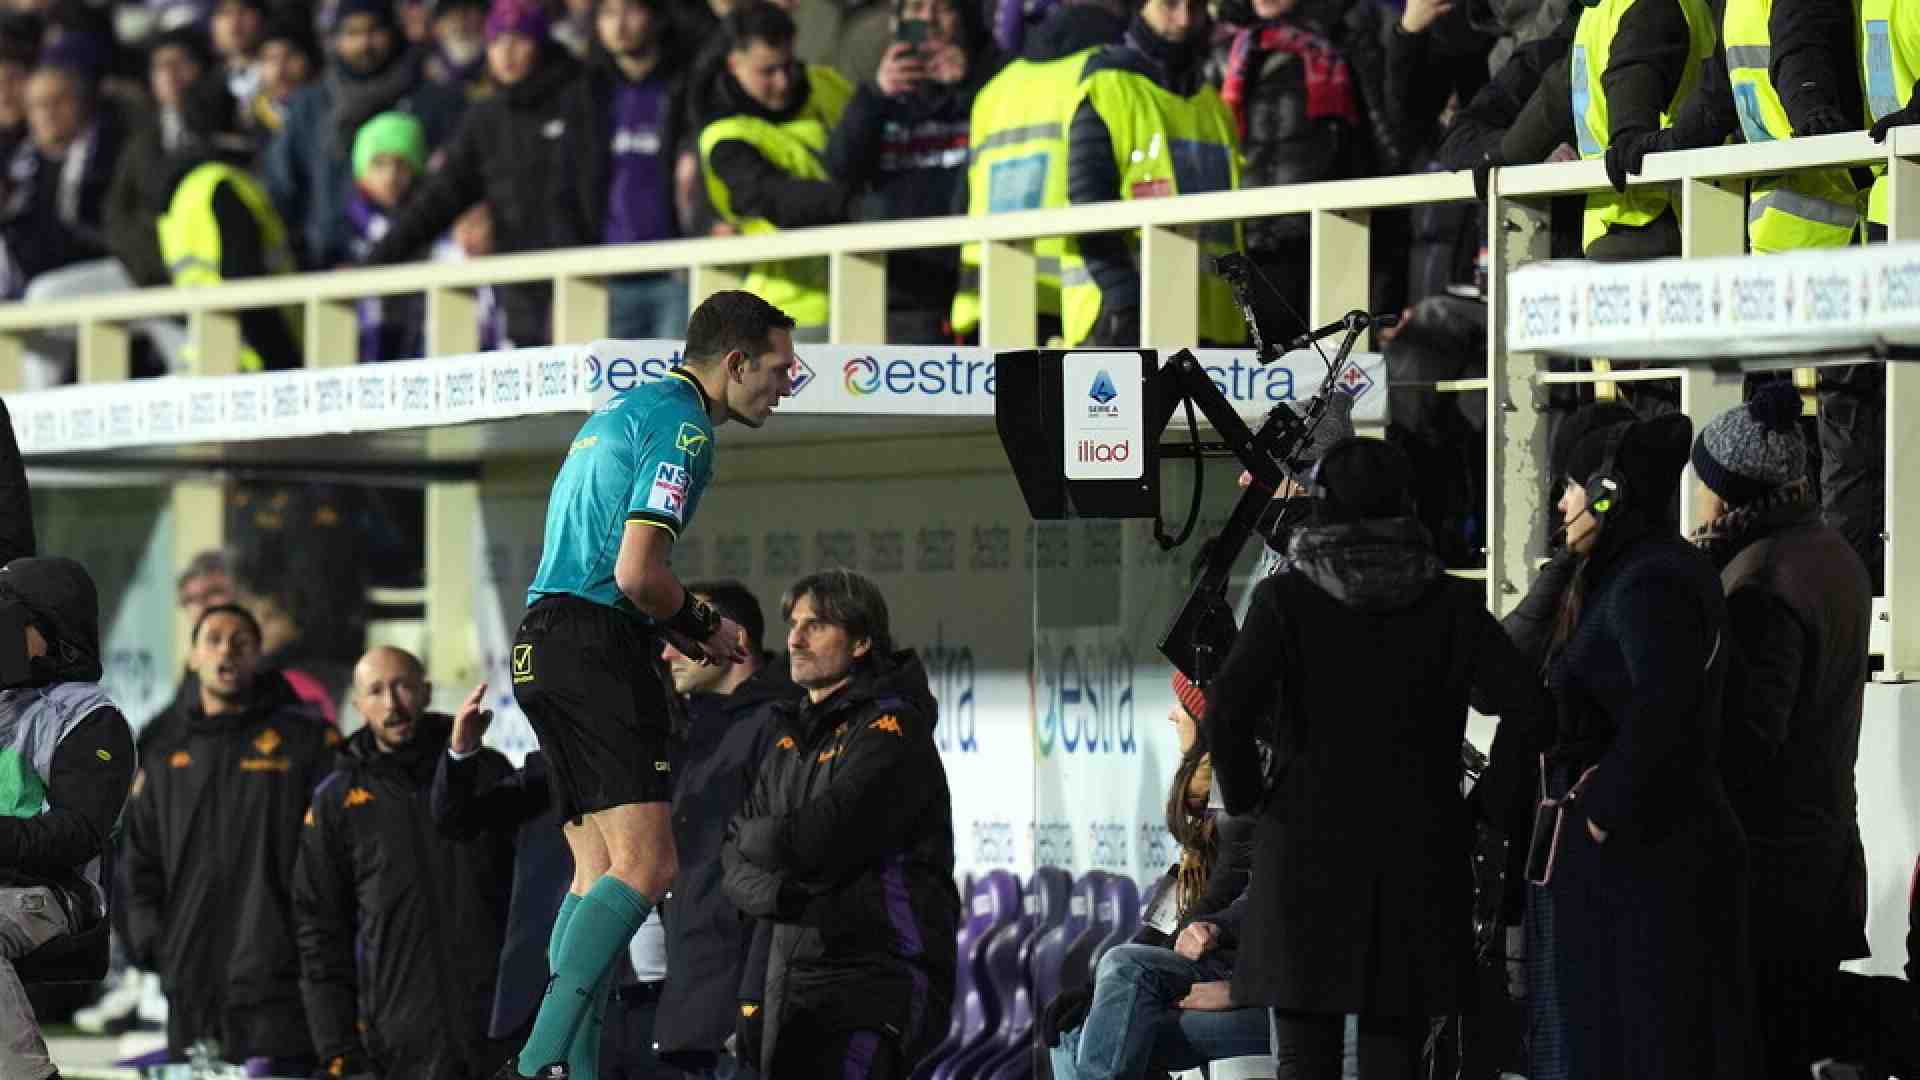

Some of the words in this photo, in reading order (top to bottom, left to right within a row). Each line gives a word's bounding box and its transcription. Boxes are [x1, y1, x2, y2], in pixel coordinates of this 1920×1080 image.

[607, 351, 684, 392] est
[1202, 357, 1297, 400] stra
[1077, 439, 1129, 462] iliad
